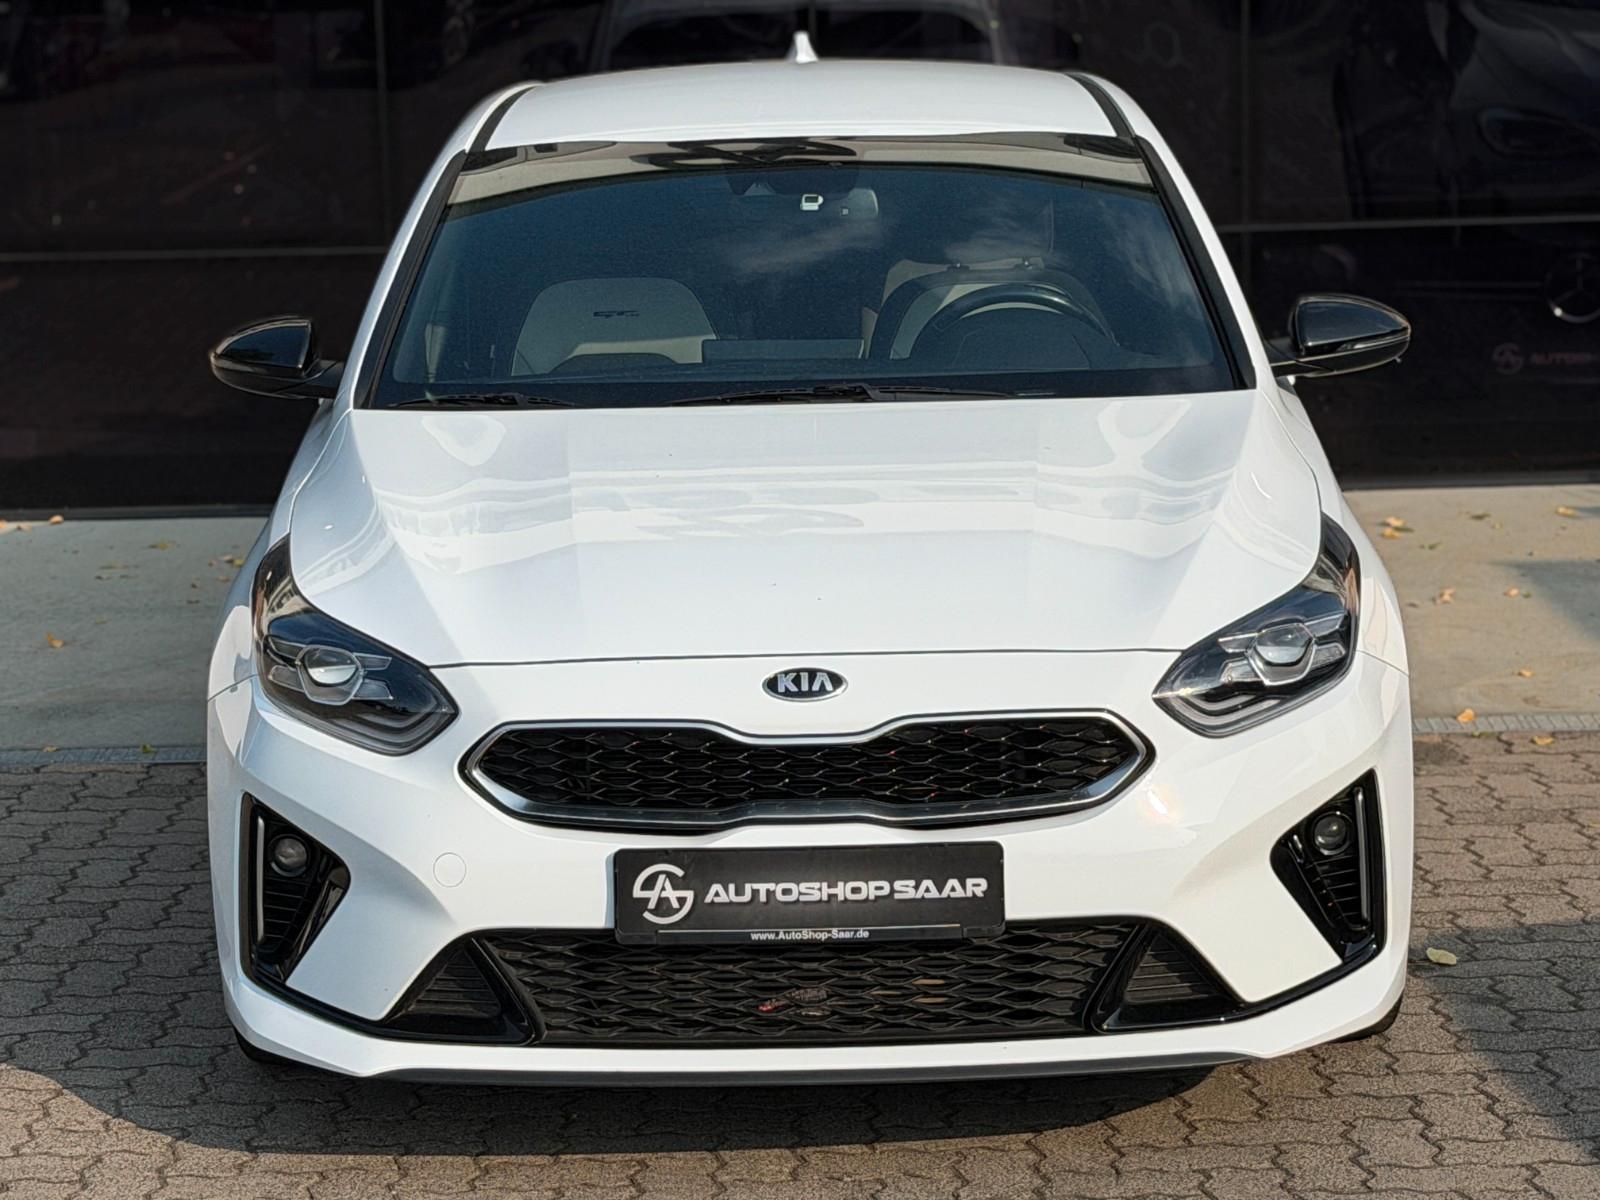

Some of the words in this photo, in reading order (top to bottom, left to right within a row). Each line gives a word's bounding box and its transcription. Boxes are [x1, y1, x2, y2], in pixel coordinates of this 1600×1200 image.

[778, 672, 834, 692] KIA
[704, 881, 890, 903] AUTOSHOP
[893, 877, 988, 900] SAAR
[751, 929, 870, 942] www.AutoShop-Saar.de
